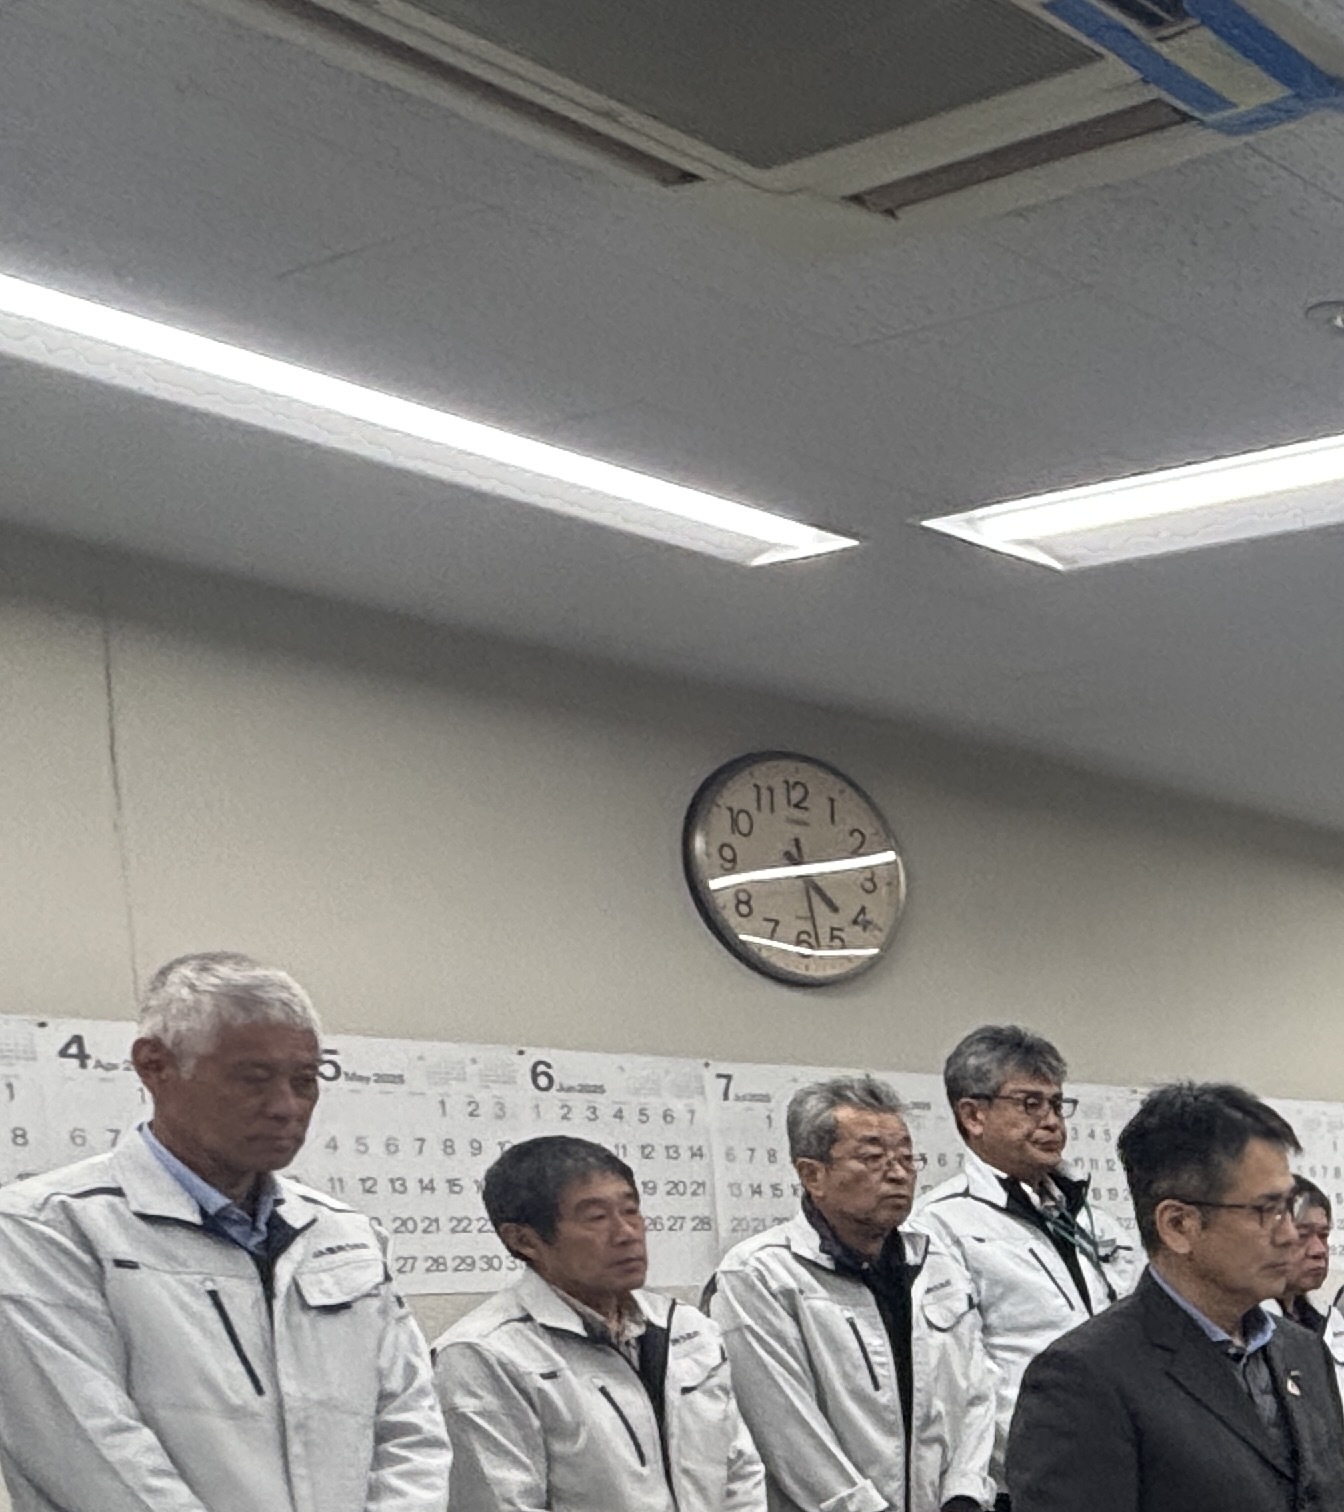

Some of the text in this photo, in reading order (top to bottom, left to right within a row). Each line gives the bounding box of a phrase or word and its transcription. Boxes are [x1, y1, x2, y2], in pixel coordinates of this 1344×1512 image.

[753, 783, 775, 814] 11
[783, 779, 810, 811] 12
[727, 806, 754, 837] 10
[827, 797, 836, 825] 1
[849, 828, 866, 853] 2
[718, 843, 738, 871] 9
[734, 888, 754, 918] 8
[763, 917, 780, 937] 7
[852, 905, 873, 932] 4
[829, 927, 846, 949] 5
[57, 1034, 92, 1069] 4
[317, 1048, 342, 1082] 5
[530, 1060, 555, 1092] 6
[5, 1081, 15, 1101] 1
[137, 1086, 146, 1104] 1
[715, 1073, 733, 1101] 7
[438, 1099, 507, 1120] 1 2 3
[533, 1103, 696, 1125] 1 2 3 4 5 6 7
[765, 1113, 773, 1129] 1
[11, 1126, 29, 1147] 8
[69, 1127, 121, 1148] 6 7
[324, 1135, 339, 1153] 4
[354, 1136, 370, 1155] 5
[384, 1136, 400, 1156] 6
[414, 1137, 427, 1155] 7
[442, 1137, 456, 1156] 8
[469, 1138, 483, 1158] 9
[640, 1144, 655, 1160] 12
[664, 1144, 681, 1160] 13
[688, 1144, 704, 1160] 14
[724, 1147, 777, 1164] 6 7 8
[327, 1176, 344, 1194] 11
[358, 1177, 378, 1195] 12
[388, 1177, 408, 1195] 13
[417, 1178, 437, 1195] 14
[445, 1178, 464, 1195] 15
[641, 1180, 706, 1196] 19 20 21
[728, 1182, 743, 1198] 13
[749, 1182, 763, 1198] 14
[769, 1183, 784, 1199] 15
[392, 1216, 418, 1234] 20
[420, 1217, 441, 1234] 21
[449, 1217, 473, 1234] 22
[667, 1216, 686, 1232] 27
[690, 1216, 712, 1232] 28
[395, 1256, 418, 1273] 27
[424, 1255, 448, 1273] 28
[452, 1255, 476, 1272] 29
[479, 1254, 503, 1272] 30
